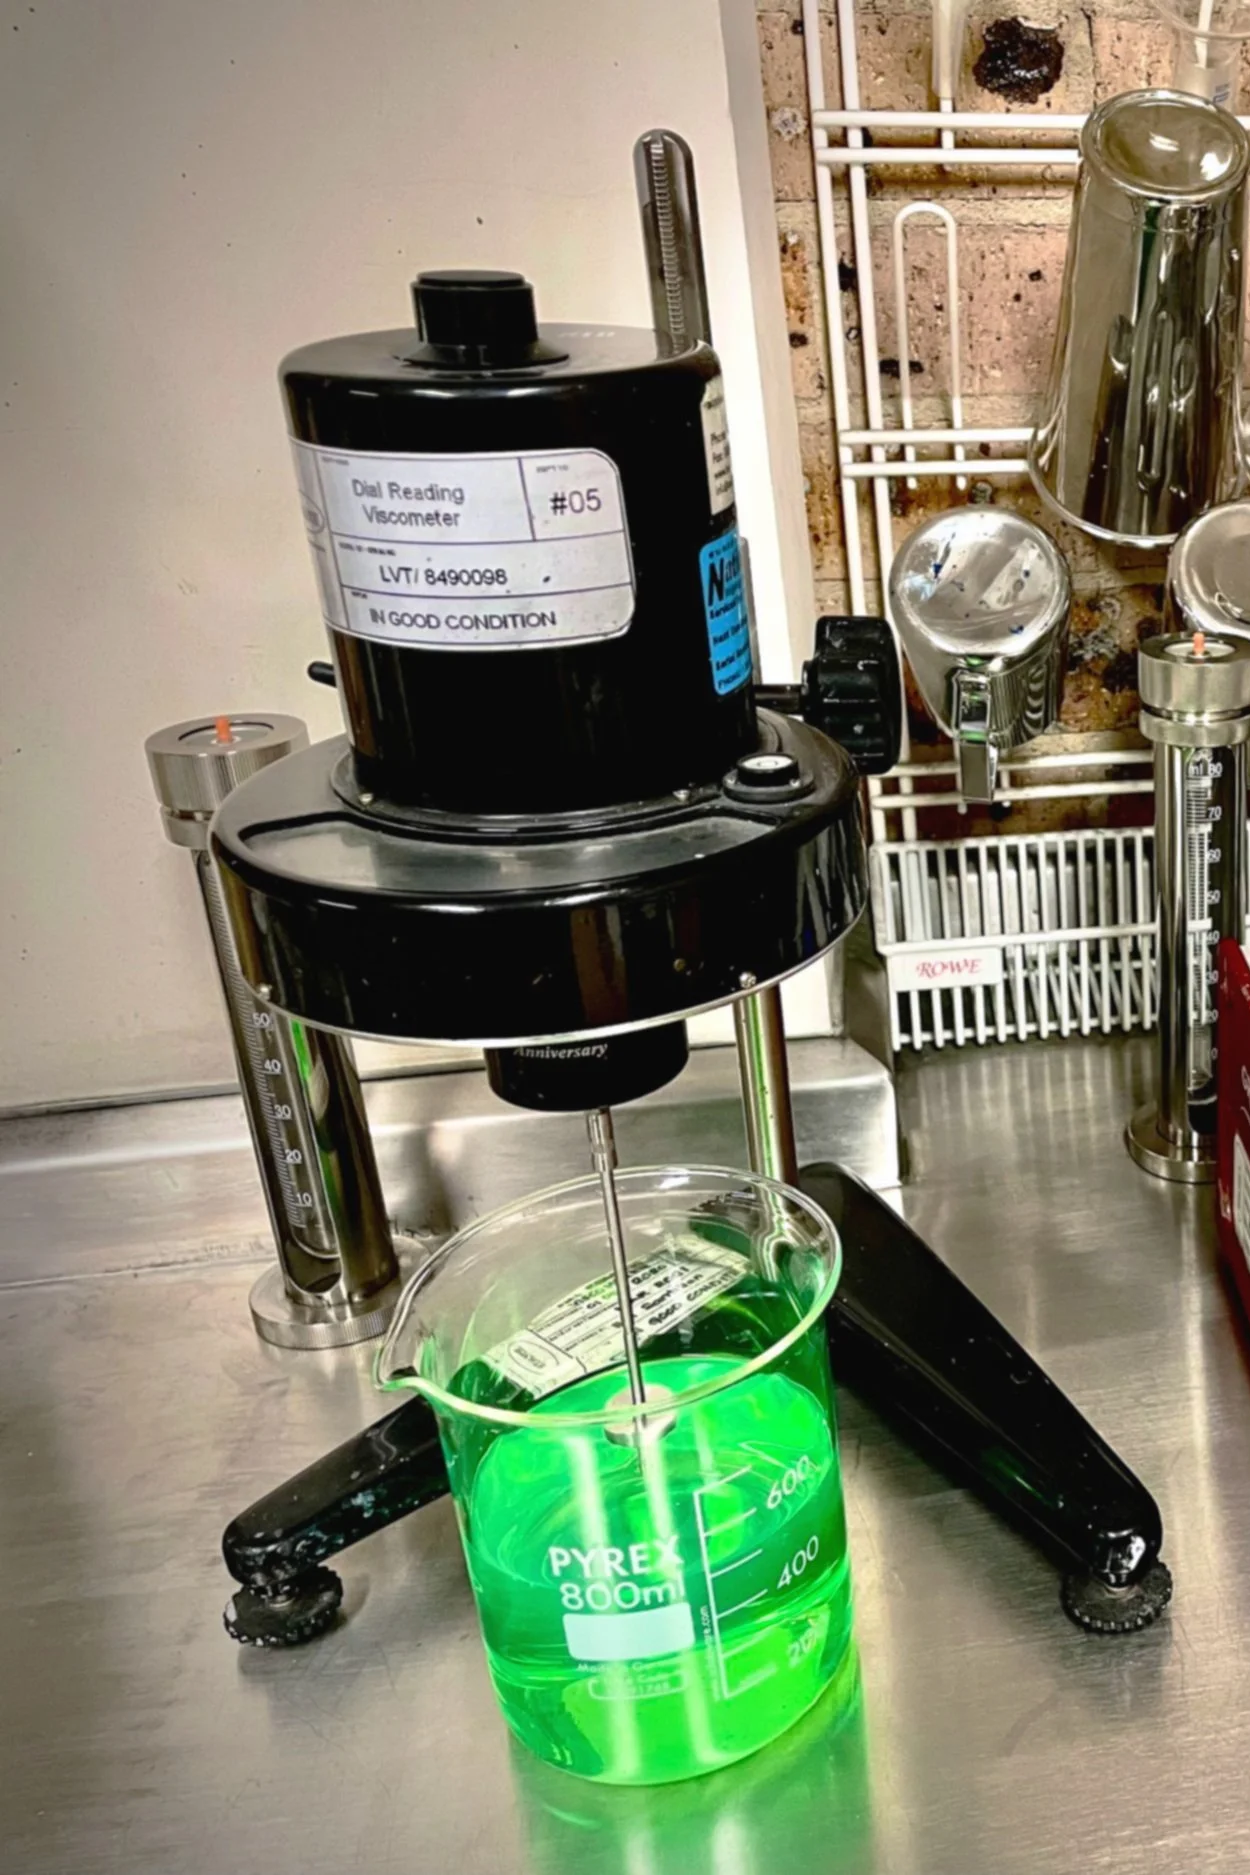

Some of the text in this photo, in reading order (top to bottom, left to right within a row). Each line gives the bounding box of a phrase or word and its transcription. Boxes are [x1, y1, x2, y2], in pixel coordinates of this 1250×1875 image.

[351, 478, 465, 505] Dial Reading
[549, 488, 602, 516] #05
[362, 504, 460, 527] Viscometer
[424, 569, 508, 586] 8490098
[369, 608, 557, 630] IN GOOD CONDITION
[1207, 762, 1223, 777] 80
[1207, 805, 1222, 820] 70
[1207, 848, 1221, 862] 60
[1208, 890, 1221, 903] 50
[916, 958, 984, 979] ROWE
[252, 1013, 271, 1026] 50
[513, 1043, 608, 1059] Anniversary
[263, 1059, 281, 1072] 40
[274, 1105, 292, 1118] 30
[286, 1149, 302, 1162] 20
[297, 1192, 312, 1205] 10
[766, 1454, 810, 1510] 600
[548, 1535, 684, 1578] PYREX
[777, 1536, 819, 1589] 400
[559, 1571, 685, 1611] 800ml
